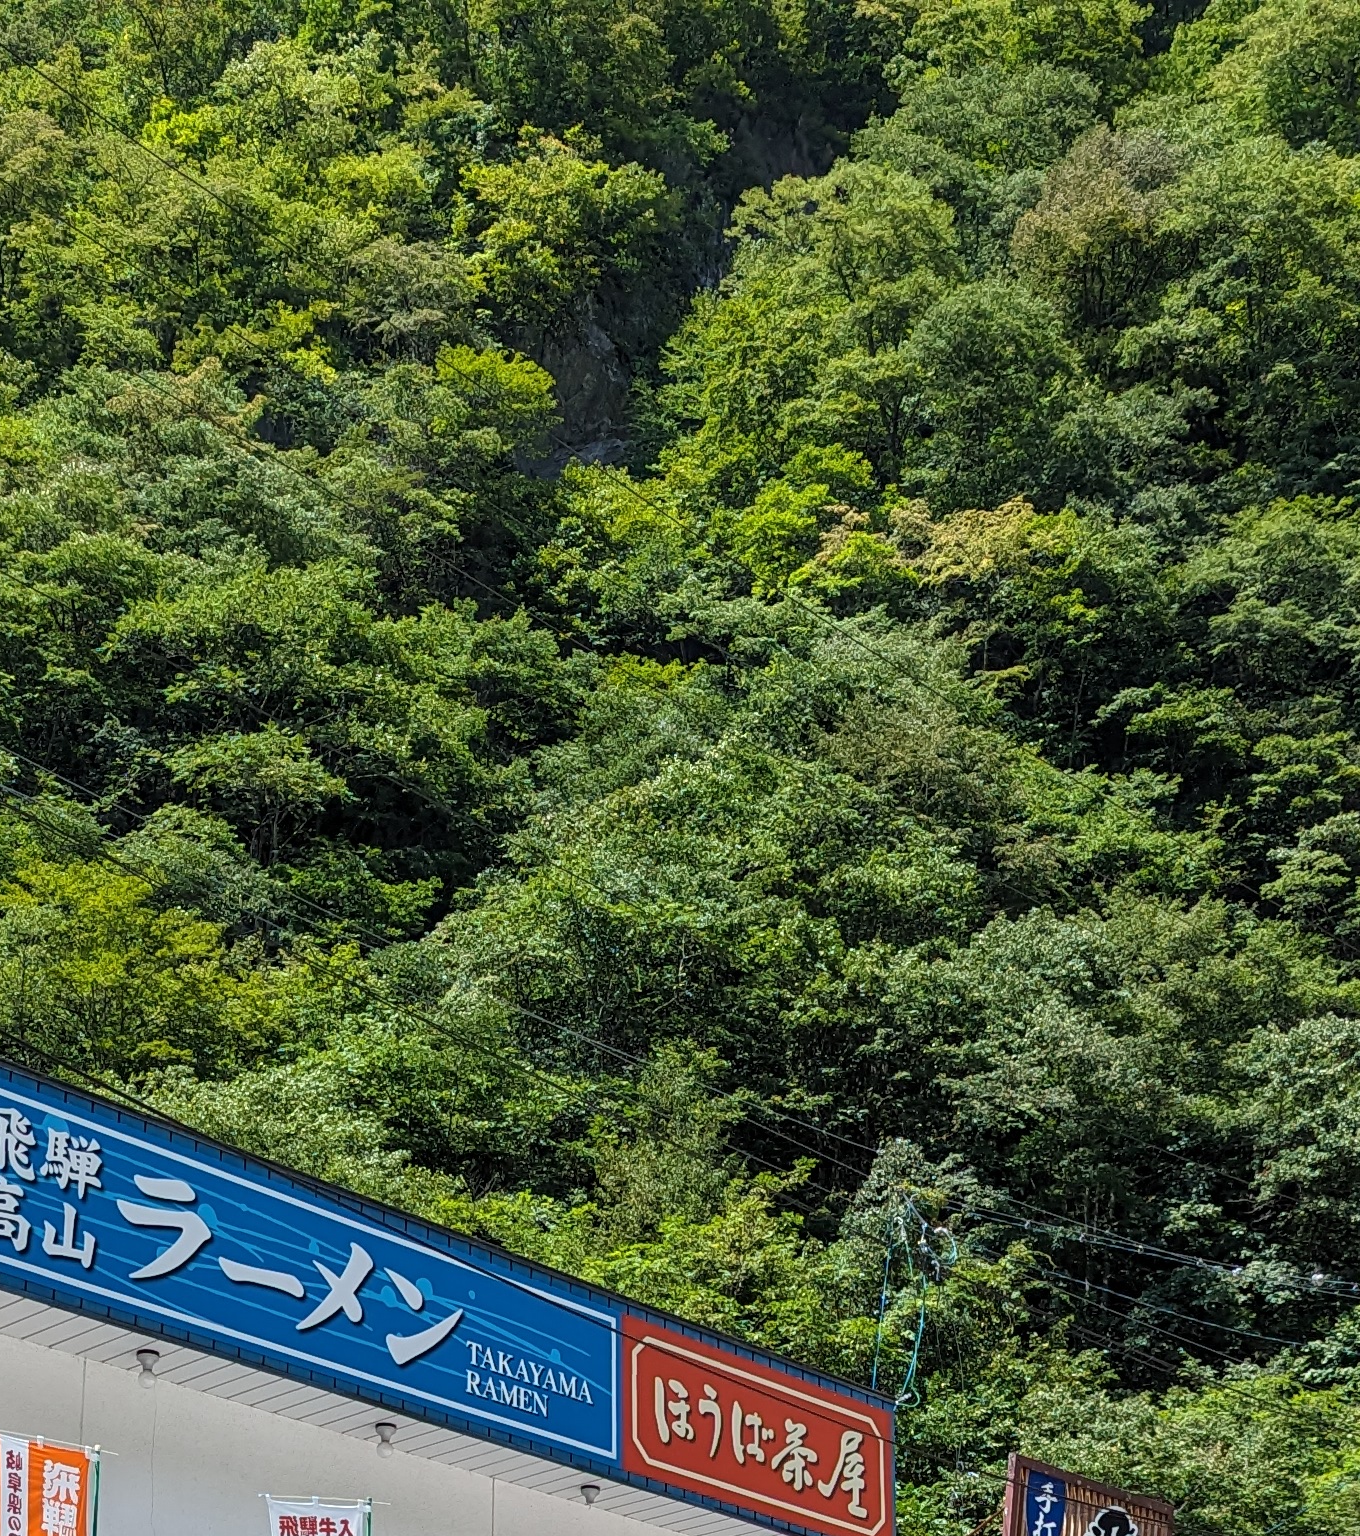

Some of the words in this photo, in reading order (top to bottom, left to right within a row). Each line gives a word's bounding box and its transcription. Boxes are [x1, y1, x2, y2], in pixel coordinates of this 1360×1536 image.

[116, 1175, 463, 1367] ラーメン
[464, 1369, 549, 1419] RAMEN
[465, 1341, 594, 1405] TAKAYAMA
[653, 1374, 871, 1521] ほうば茶屋
